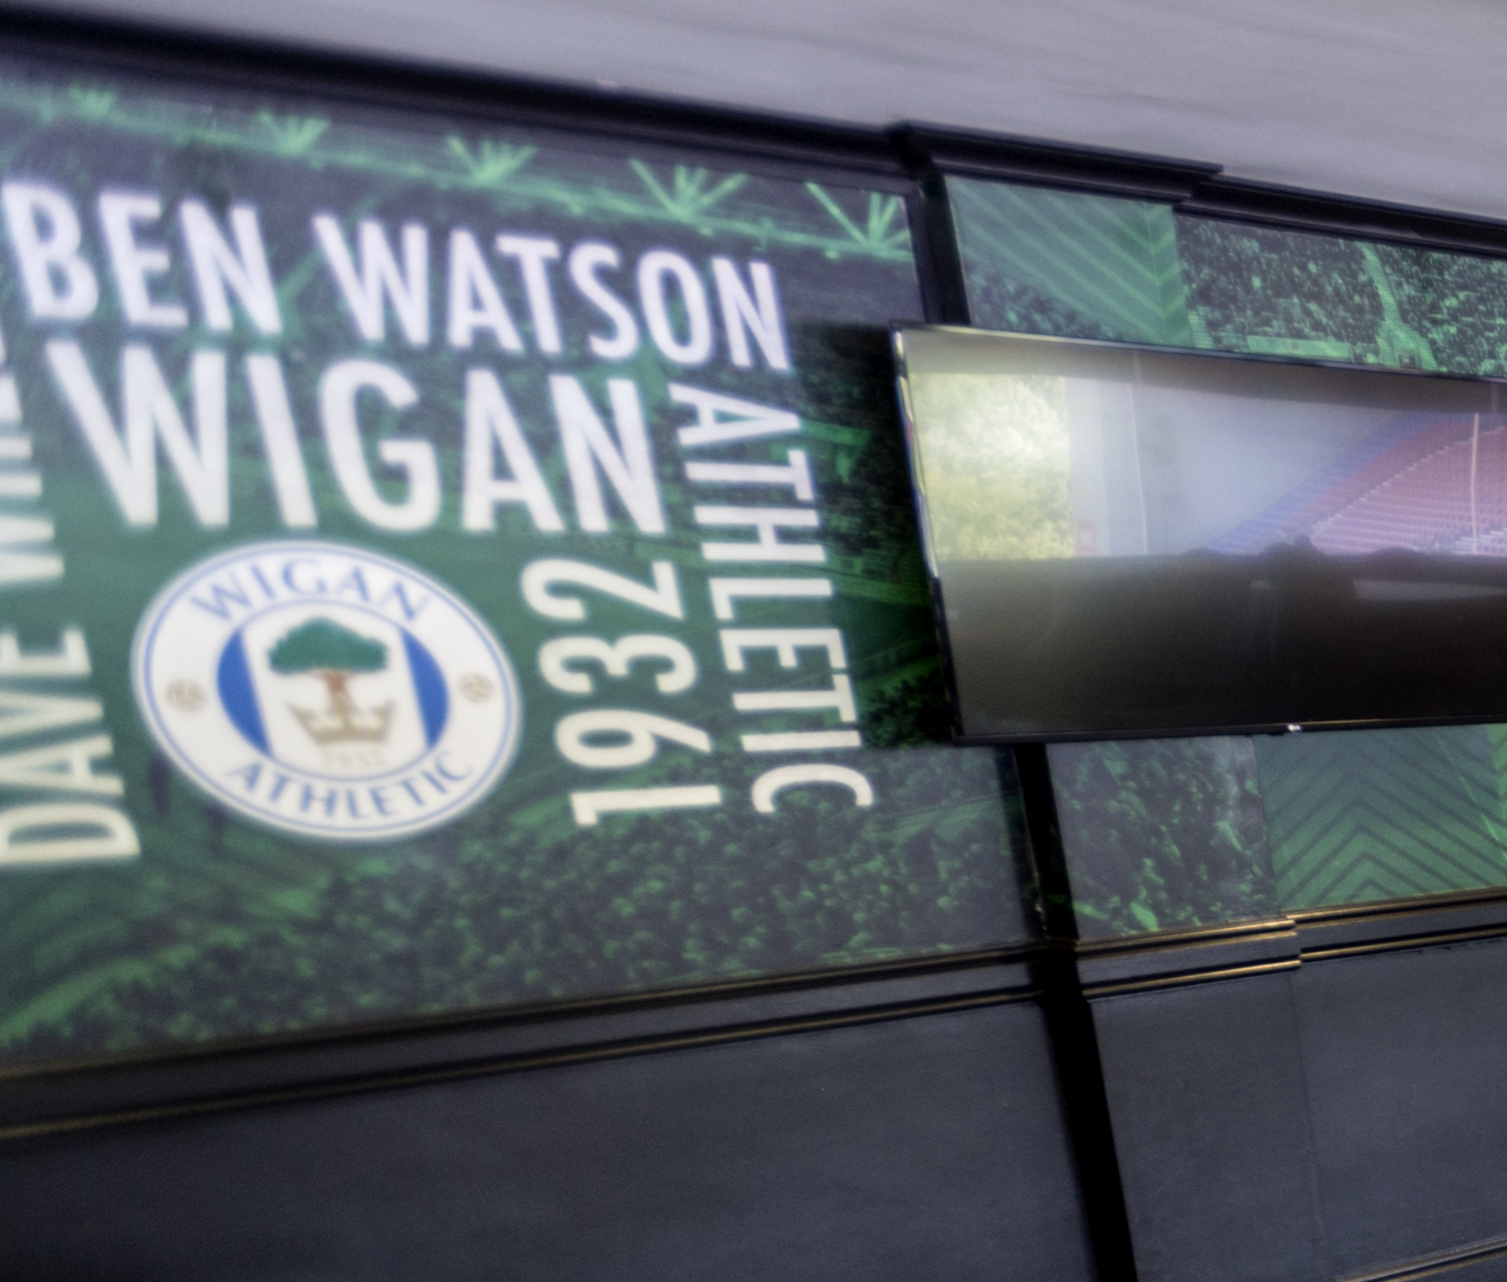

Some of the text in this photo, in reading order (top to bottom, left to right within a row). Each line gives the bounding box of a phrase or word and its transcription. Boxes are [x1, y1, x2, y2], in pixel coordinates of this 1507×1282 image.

[2, 180, 793, 372] BEN WATSON
[45, 339, 668, 537] WIGAN
[188, 557, 430, 624] WIGAN
[668, 381, 877, 815] ATHLETIC
[226, 751, 473, 820] ATHLETIC
[520, 557, 723, 827] 1932
